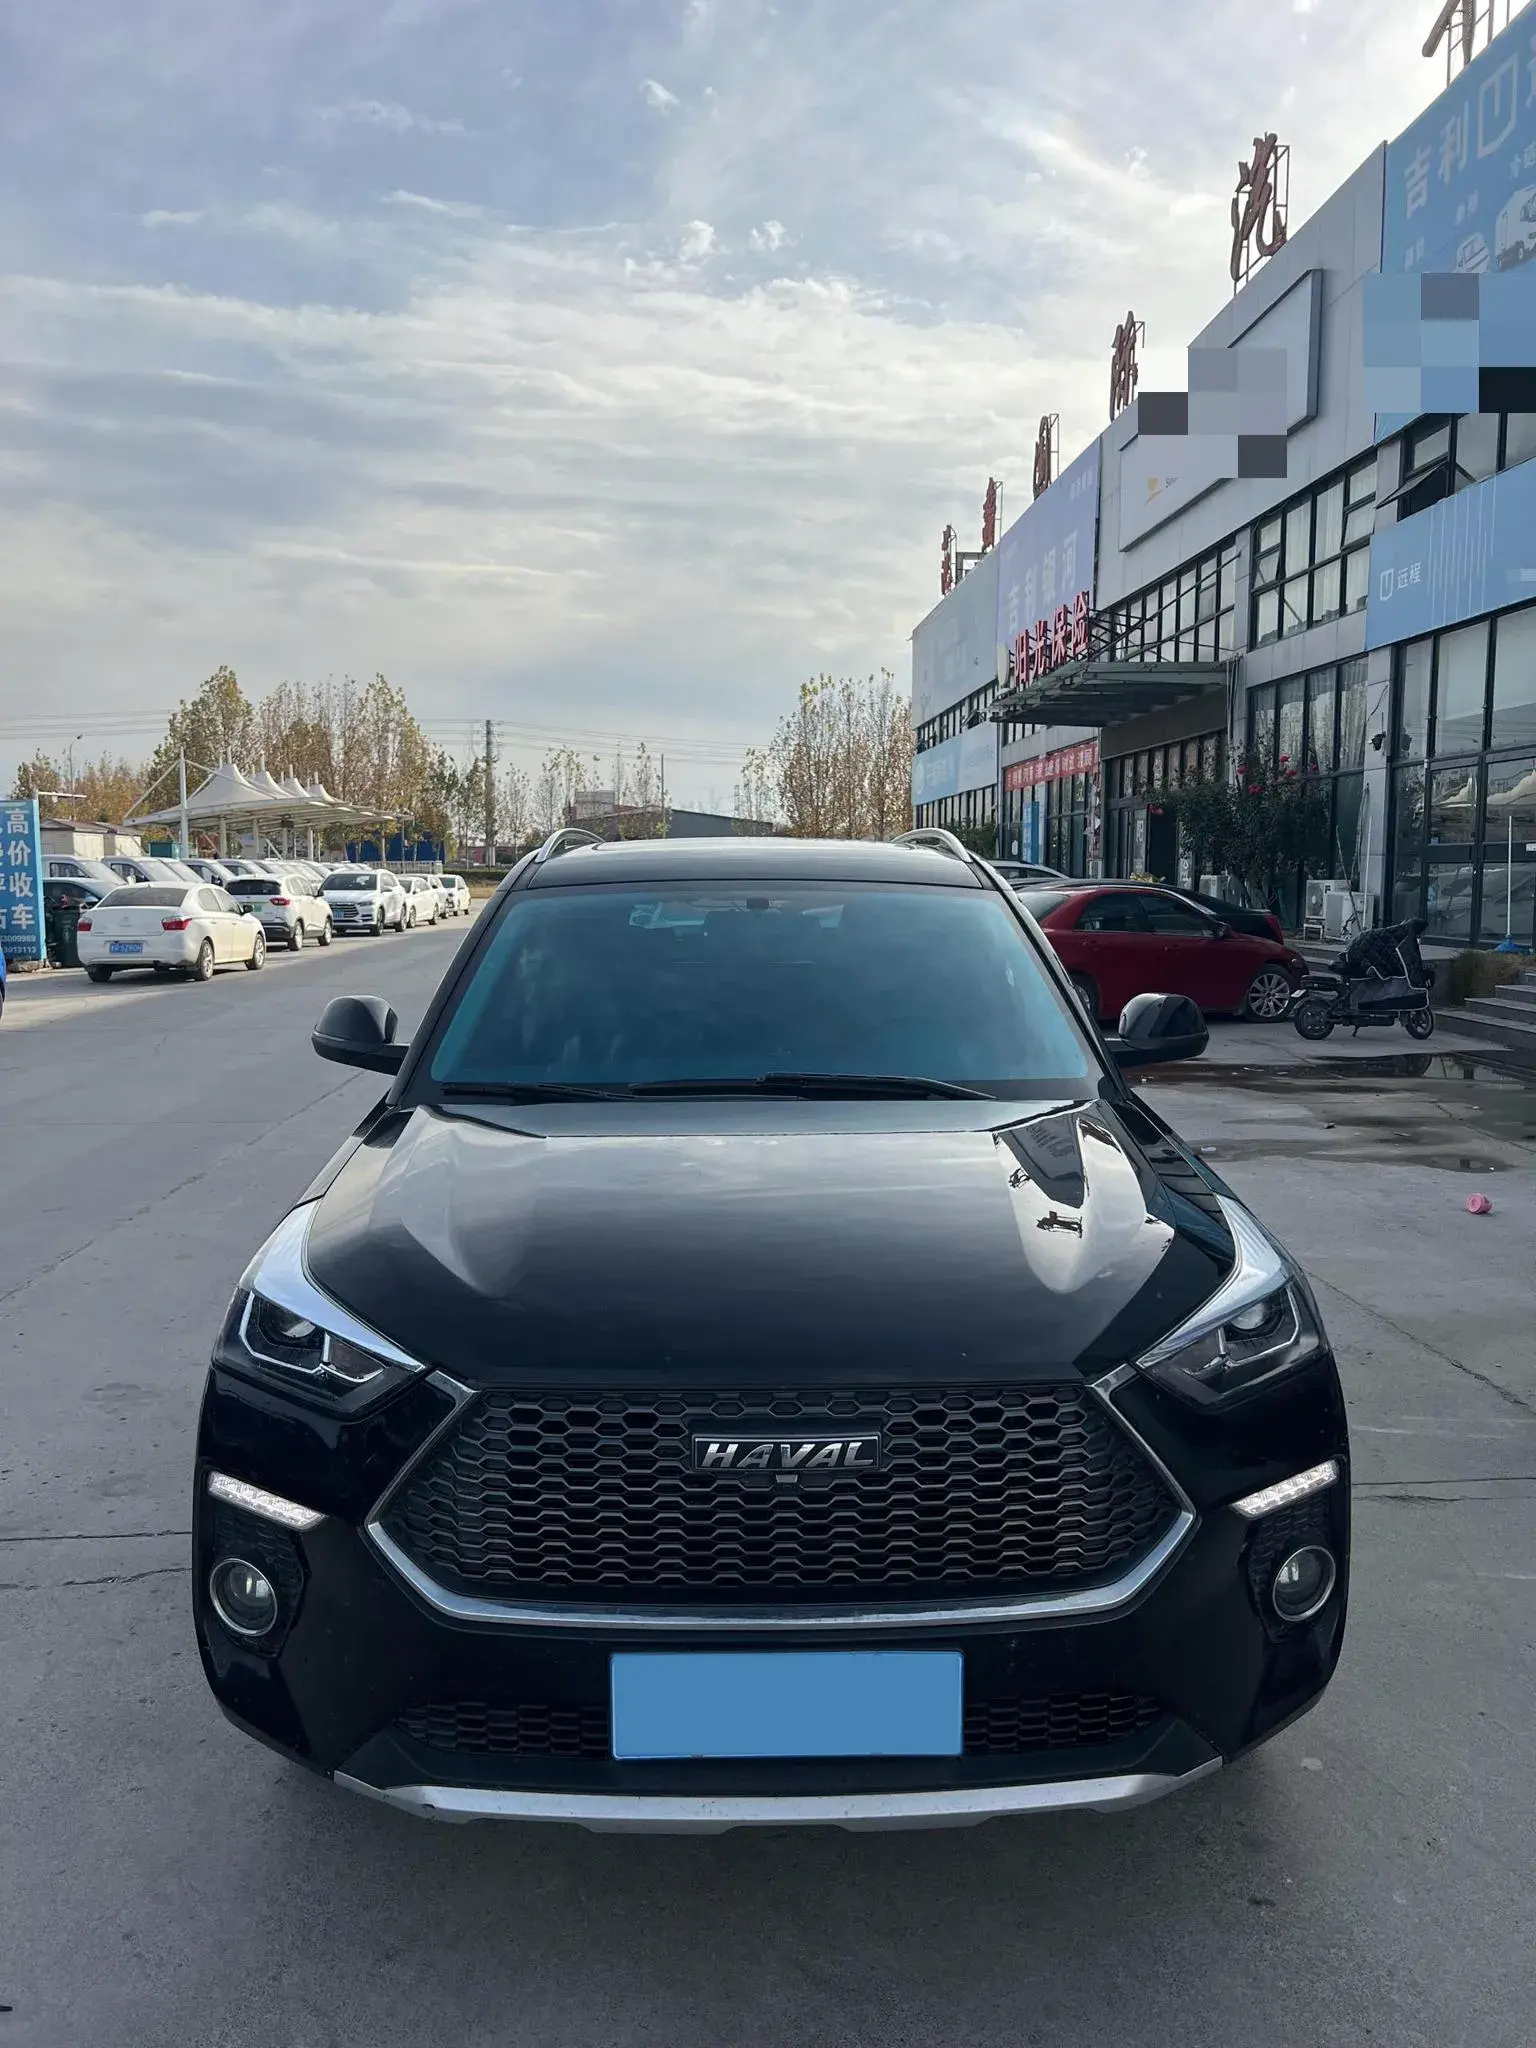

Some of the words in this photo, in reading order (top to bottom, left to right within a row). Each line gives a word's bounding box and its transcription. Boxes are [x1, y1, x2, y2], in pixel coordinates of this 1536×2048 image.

[1404, 101, 1470, 219] 吉利
[1397, 561, 1421, 590] 远程
[1013, 590, 1090, 688] 阳光保险
[5, 808, 35, 930] 高价收车
[701, 1441, 874, 1468] HAVAL
